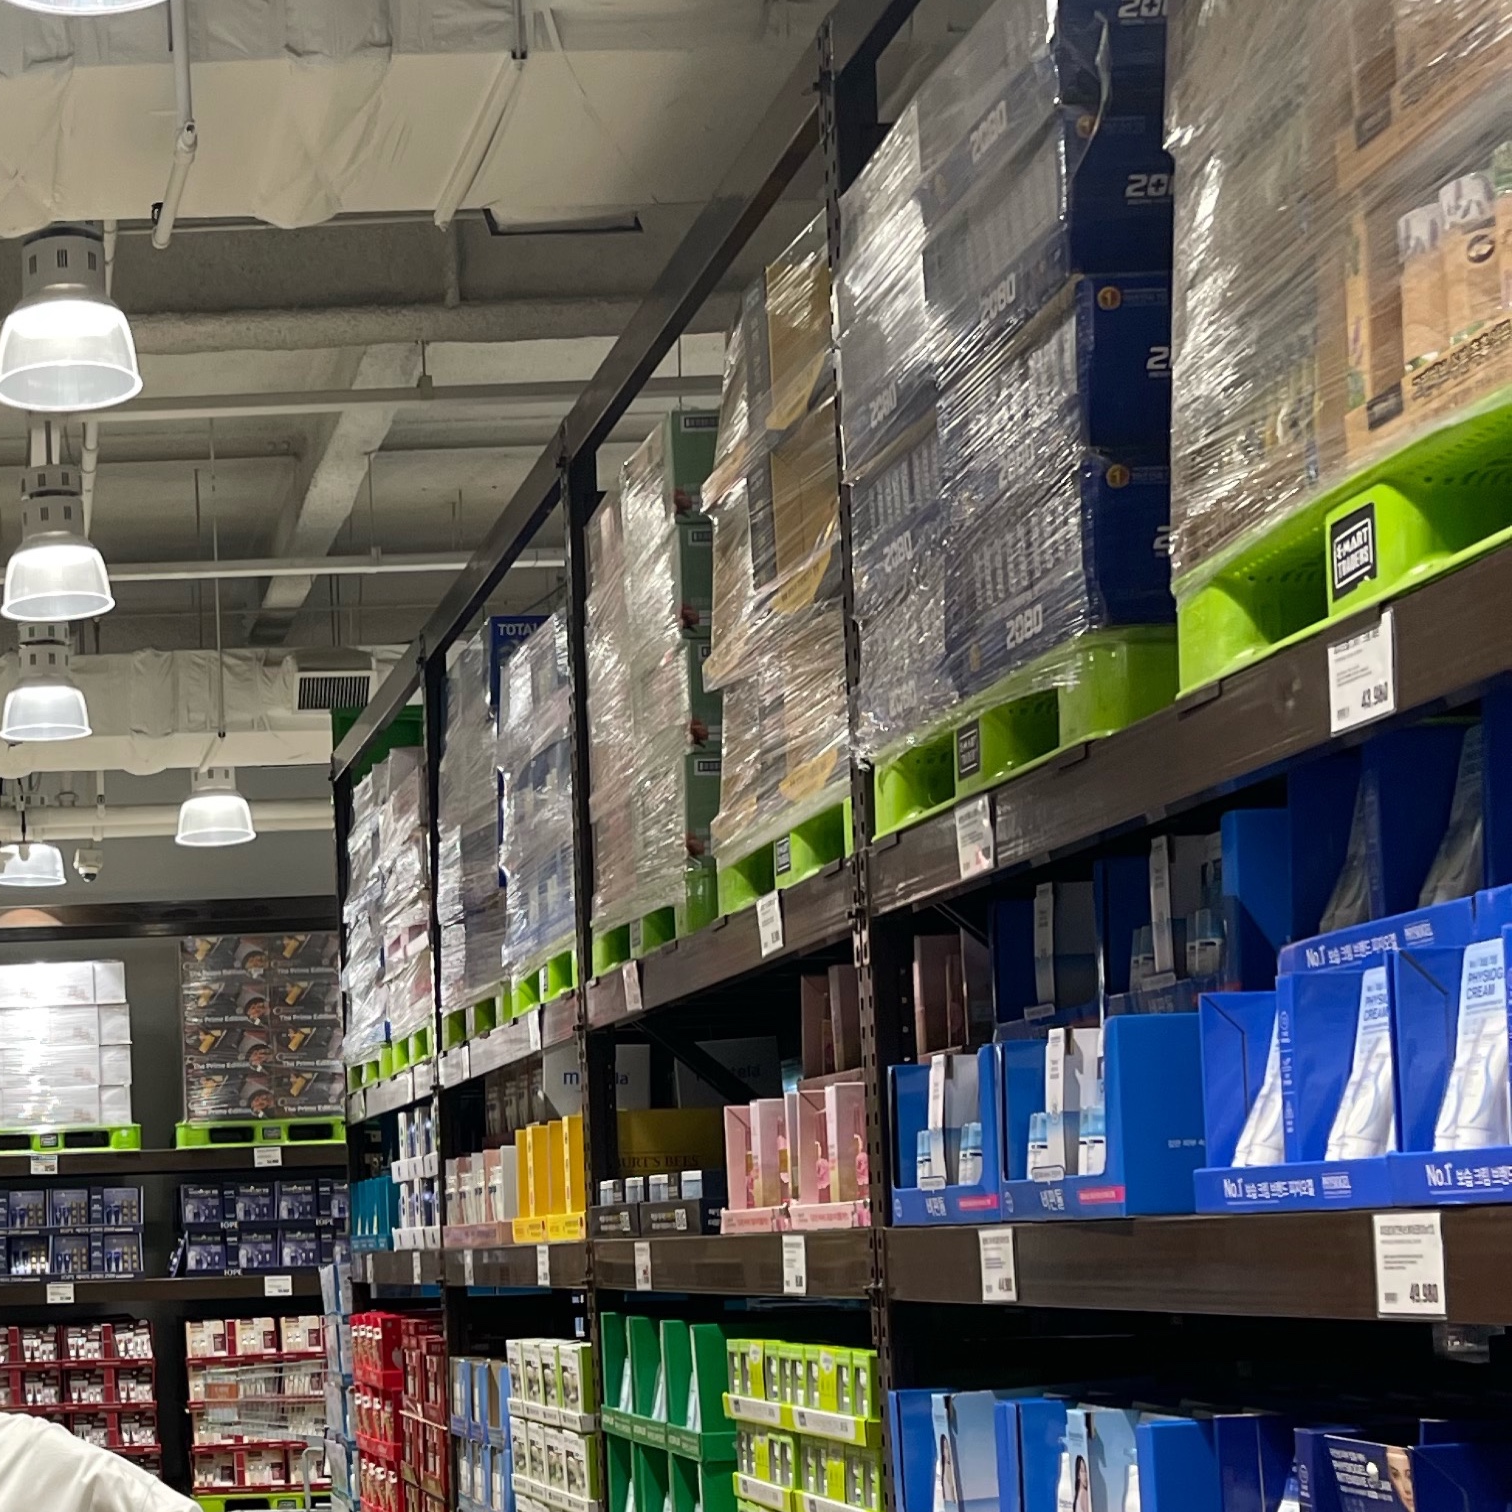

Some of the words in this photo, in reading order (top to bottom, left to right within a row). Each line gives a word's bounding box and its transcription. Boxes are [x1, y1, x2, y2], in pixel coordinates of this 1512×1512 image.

[1006, 603, 1044, 649] 2080
[220, 1221, 239, 1230] IOPE
[223, 1269, 244, 1278] IOPE
